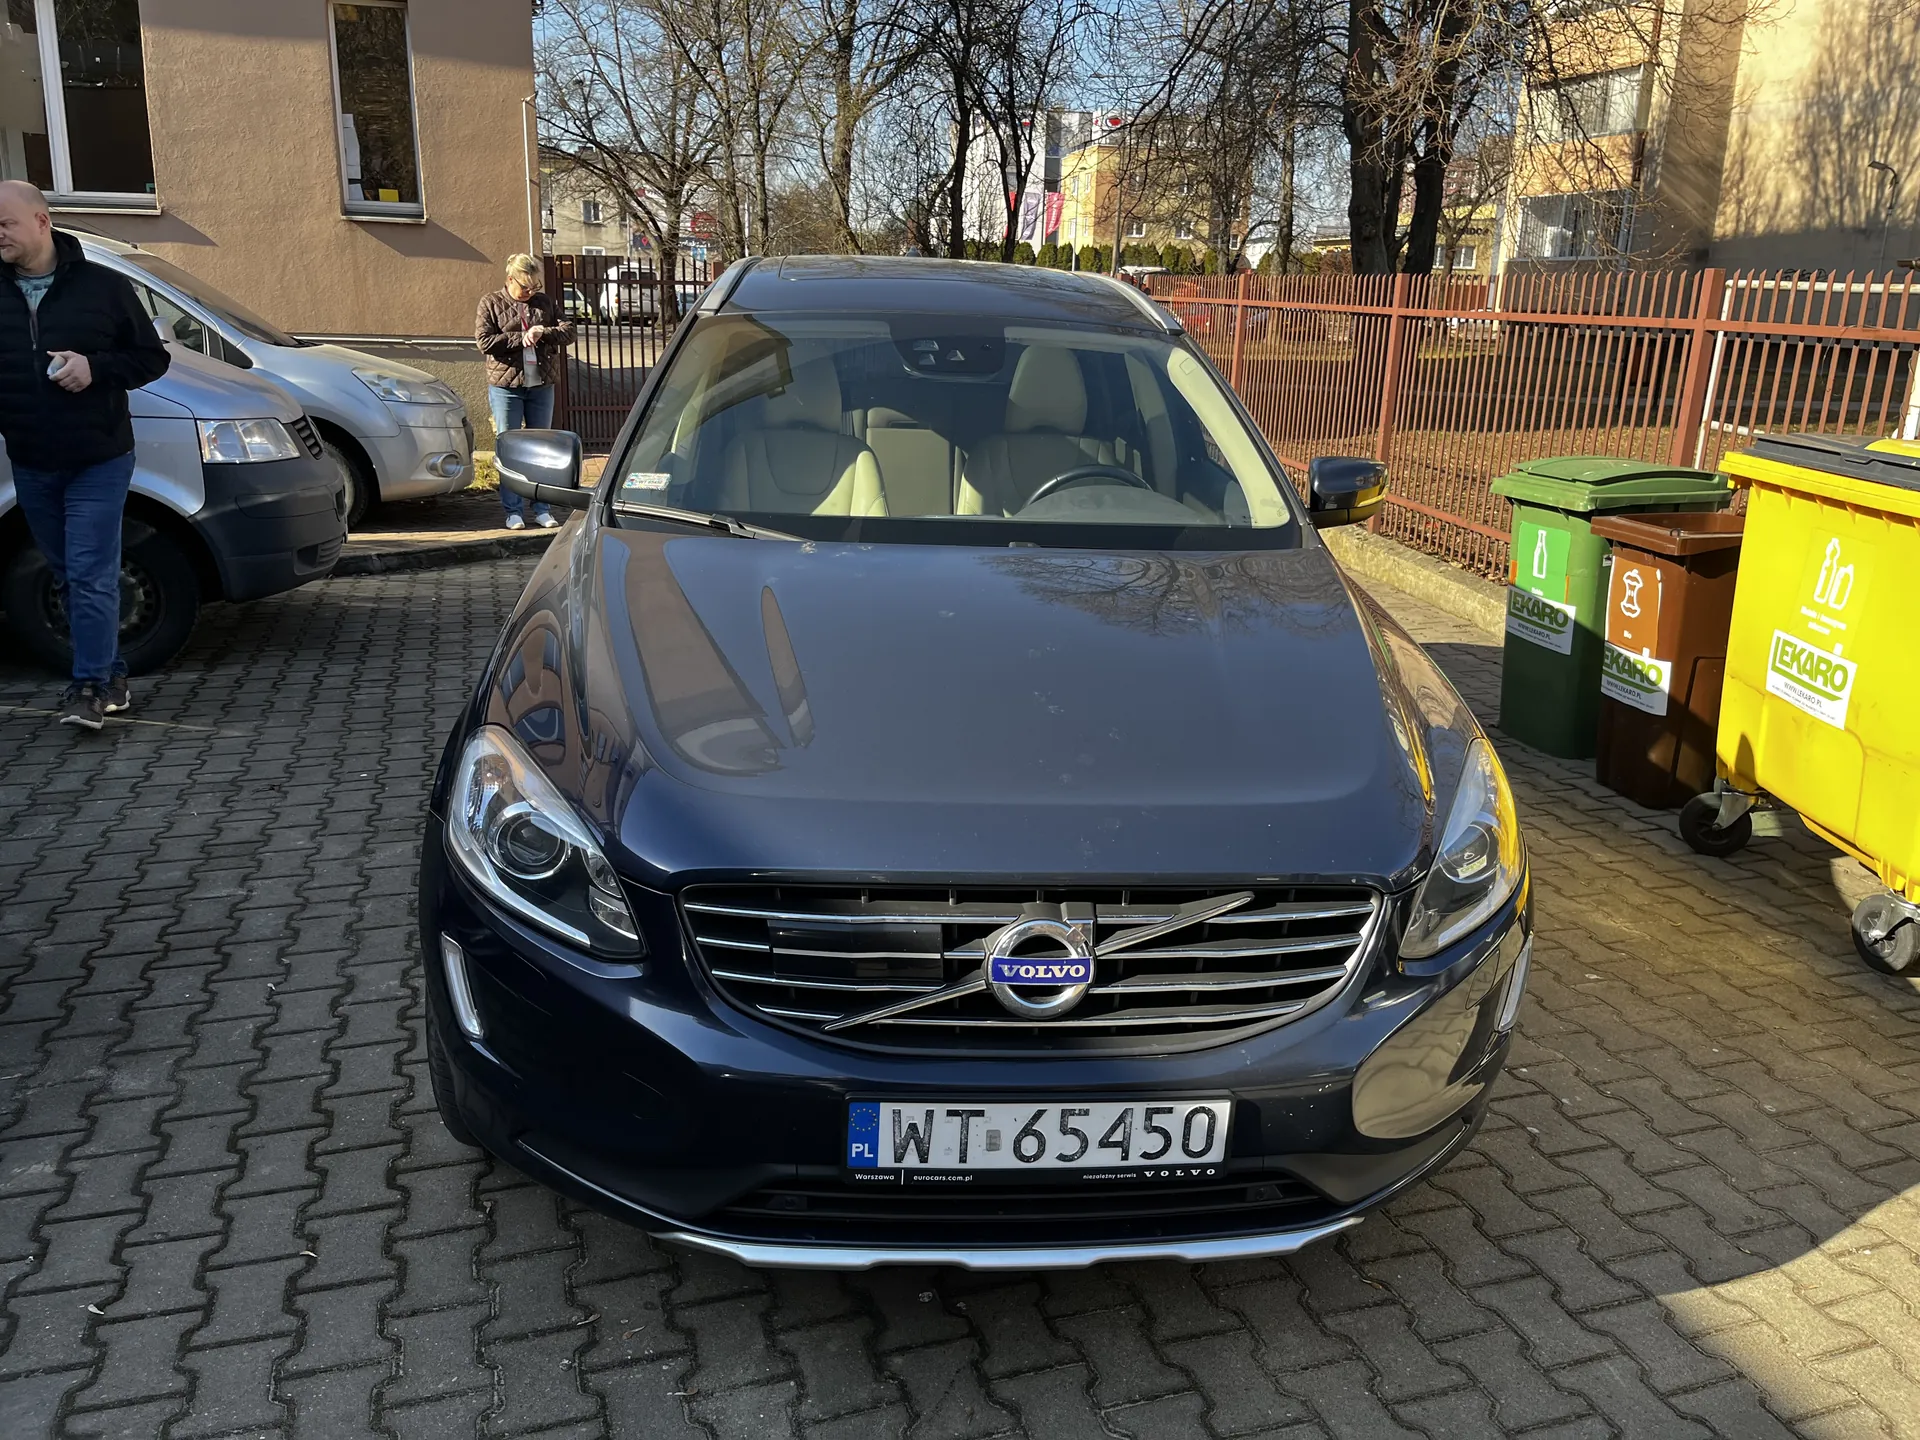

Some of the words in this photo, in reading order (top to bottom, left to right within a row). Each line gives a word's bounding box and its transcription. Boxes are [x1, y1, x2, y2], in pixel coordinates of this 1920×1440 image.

[1602, 645, 1663, 694] EKARO
[1771, 636, 1849, 701] LEKARO
[998, 964, 1085, 979] VOLVO
[851, 1143, 874, 1158] PL
[892, 1108, 985, 1164] WT
[1013, 1105, 1216, 1163] 65450
[854, 1173, 895, 1181] Warszawa
[913, 1174, 973, 1182] eurocars.com.pl
[1143, 1168, 1216, 1178] VOLVO
